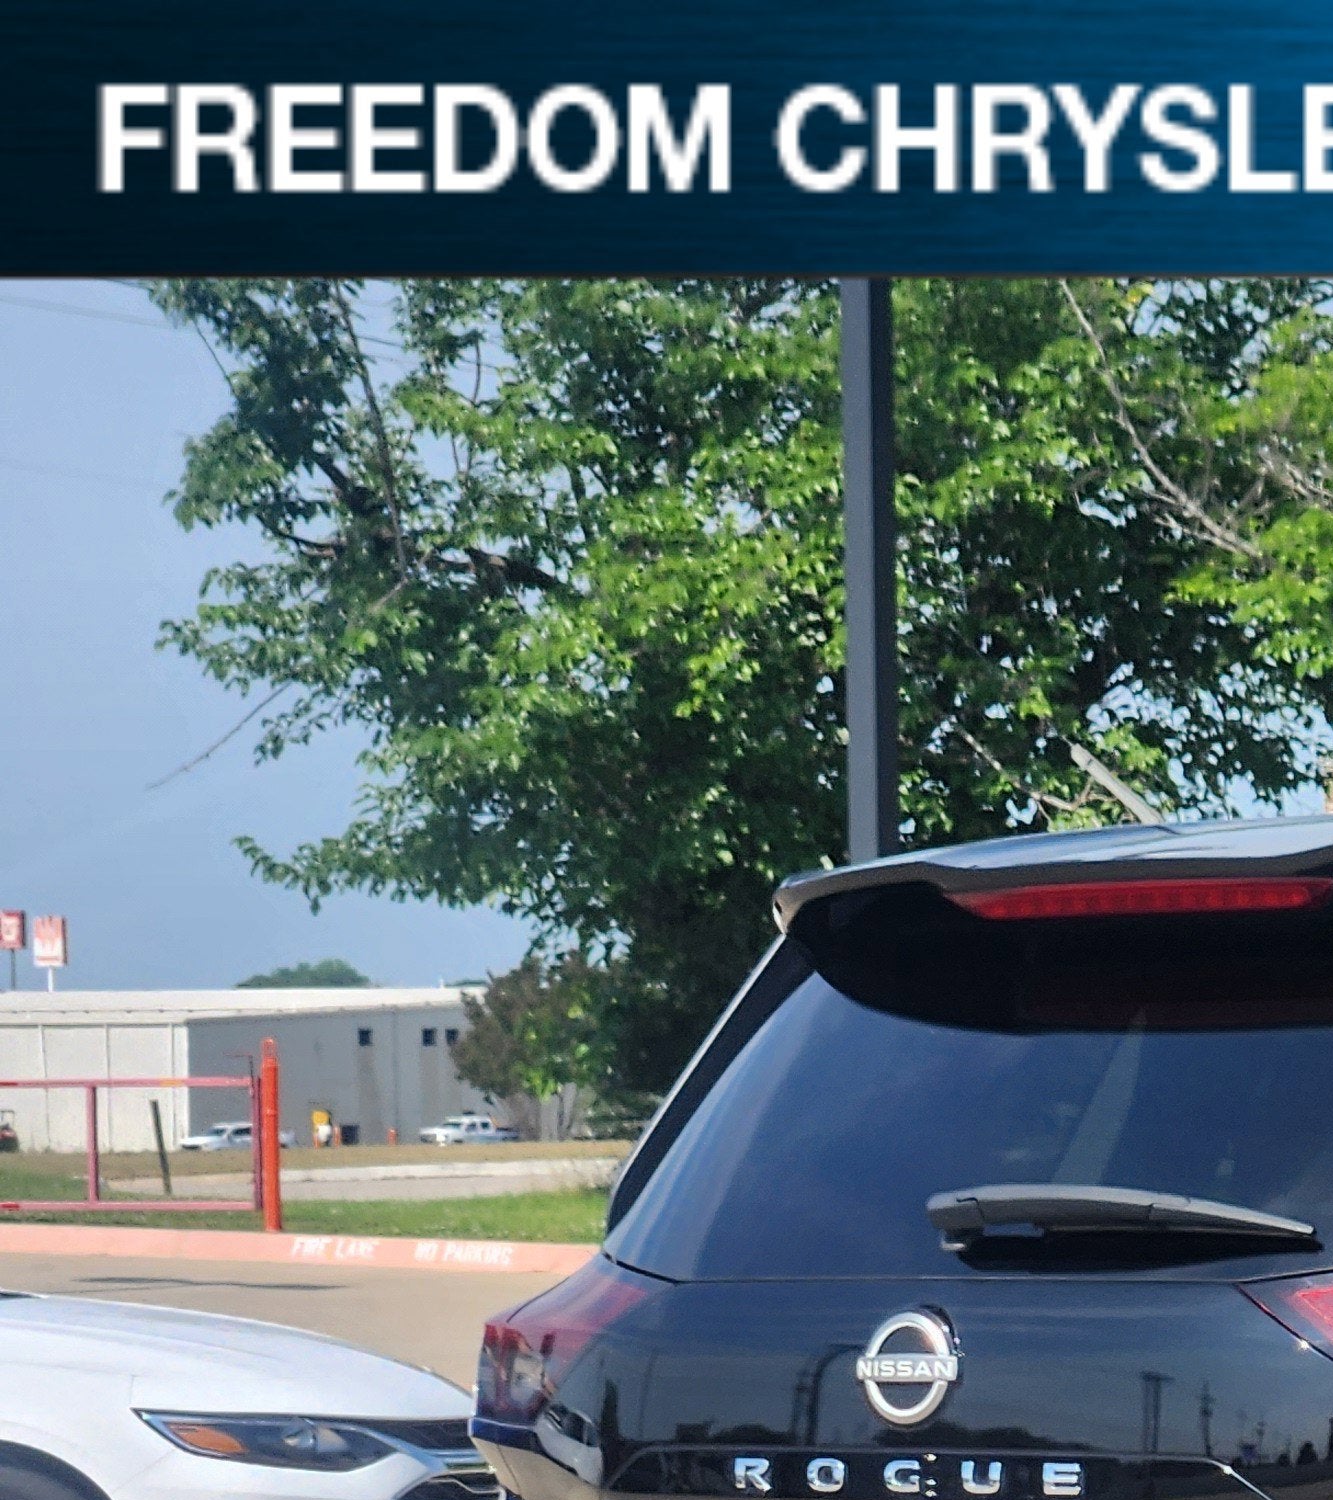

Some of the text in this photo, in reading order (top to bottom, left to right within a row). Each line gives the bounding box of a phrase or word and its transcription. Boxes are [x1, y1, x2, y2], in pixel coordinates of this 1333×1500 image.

[413, 1240, 515, 1266] NO PARKING
[858, 1359, 954, 1378] NISSAN
[733, 1456, 1083, 1497] ROGUE
